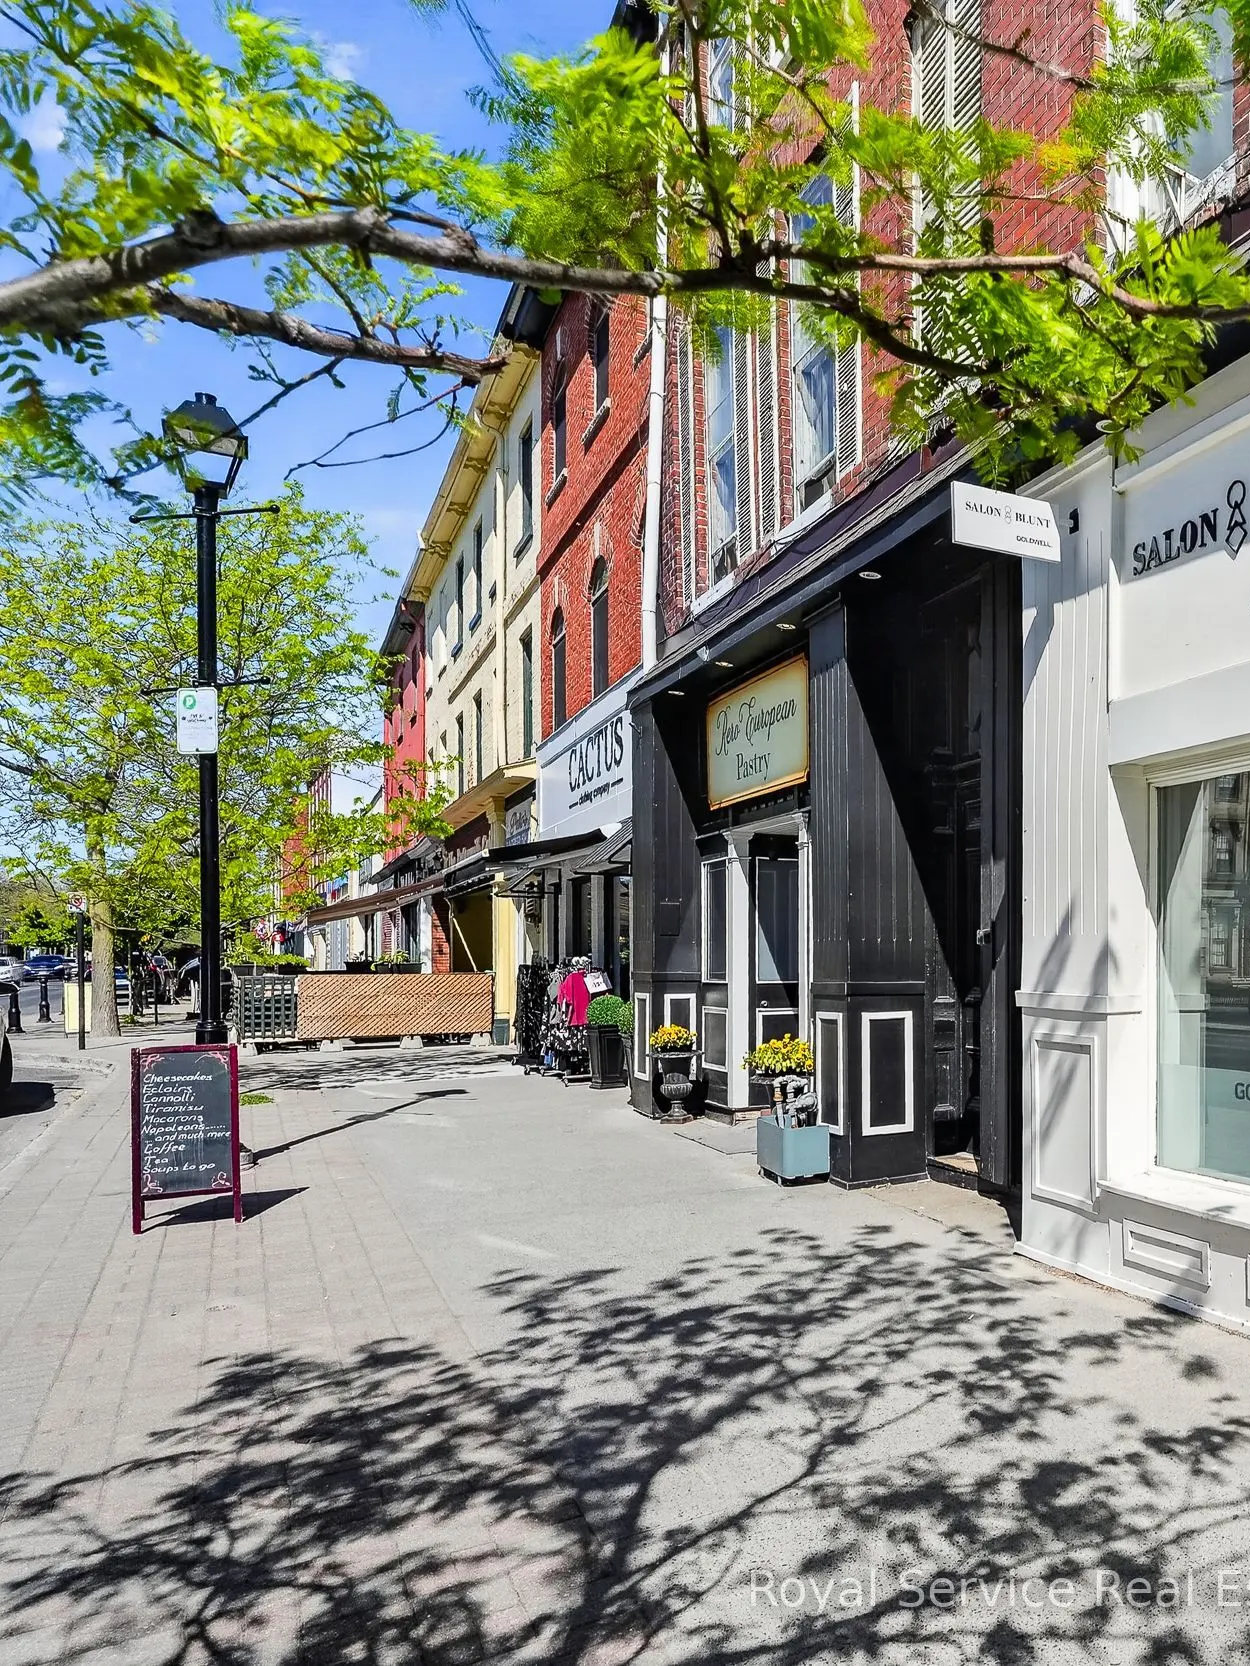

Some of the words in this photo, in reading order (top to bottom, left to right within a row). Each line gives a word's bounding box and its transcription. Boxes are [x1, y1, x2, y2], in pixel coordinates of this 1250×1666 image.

[965, 501, 1002, 516] SALON
[1015, 513, 1051, 528] BLUNT
[1133, 508, 1219, 576] SALON
[738, 696, 798, 746] European
[569, 716, 624, 792] CACTUS
[736, 752, 771, 781] Pastry
[143, 1072, 213, 1083] Cheesecakes
[142, 1083, 193, 1094] Eclairs
[143, 1103, 204, 1114] Tiramisu
[142, 1115, 204, 1125] Macarons
[154, 1132, 178, 1142] and
[178, 1130, 204, 1140] much
[207, 1131, 232, 1139] more
[144, 1141, 186, 1154] Coffee
[144, 1155, 169, 1167] Tea
[142, 1165, 179, 1174] Soups
[182, 1162, 196, 1171] to
[199, 1163, 216, 1171] go
